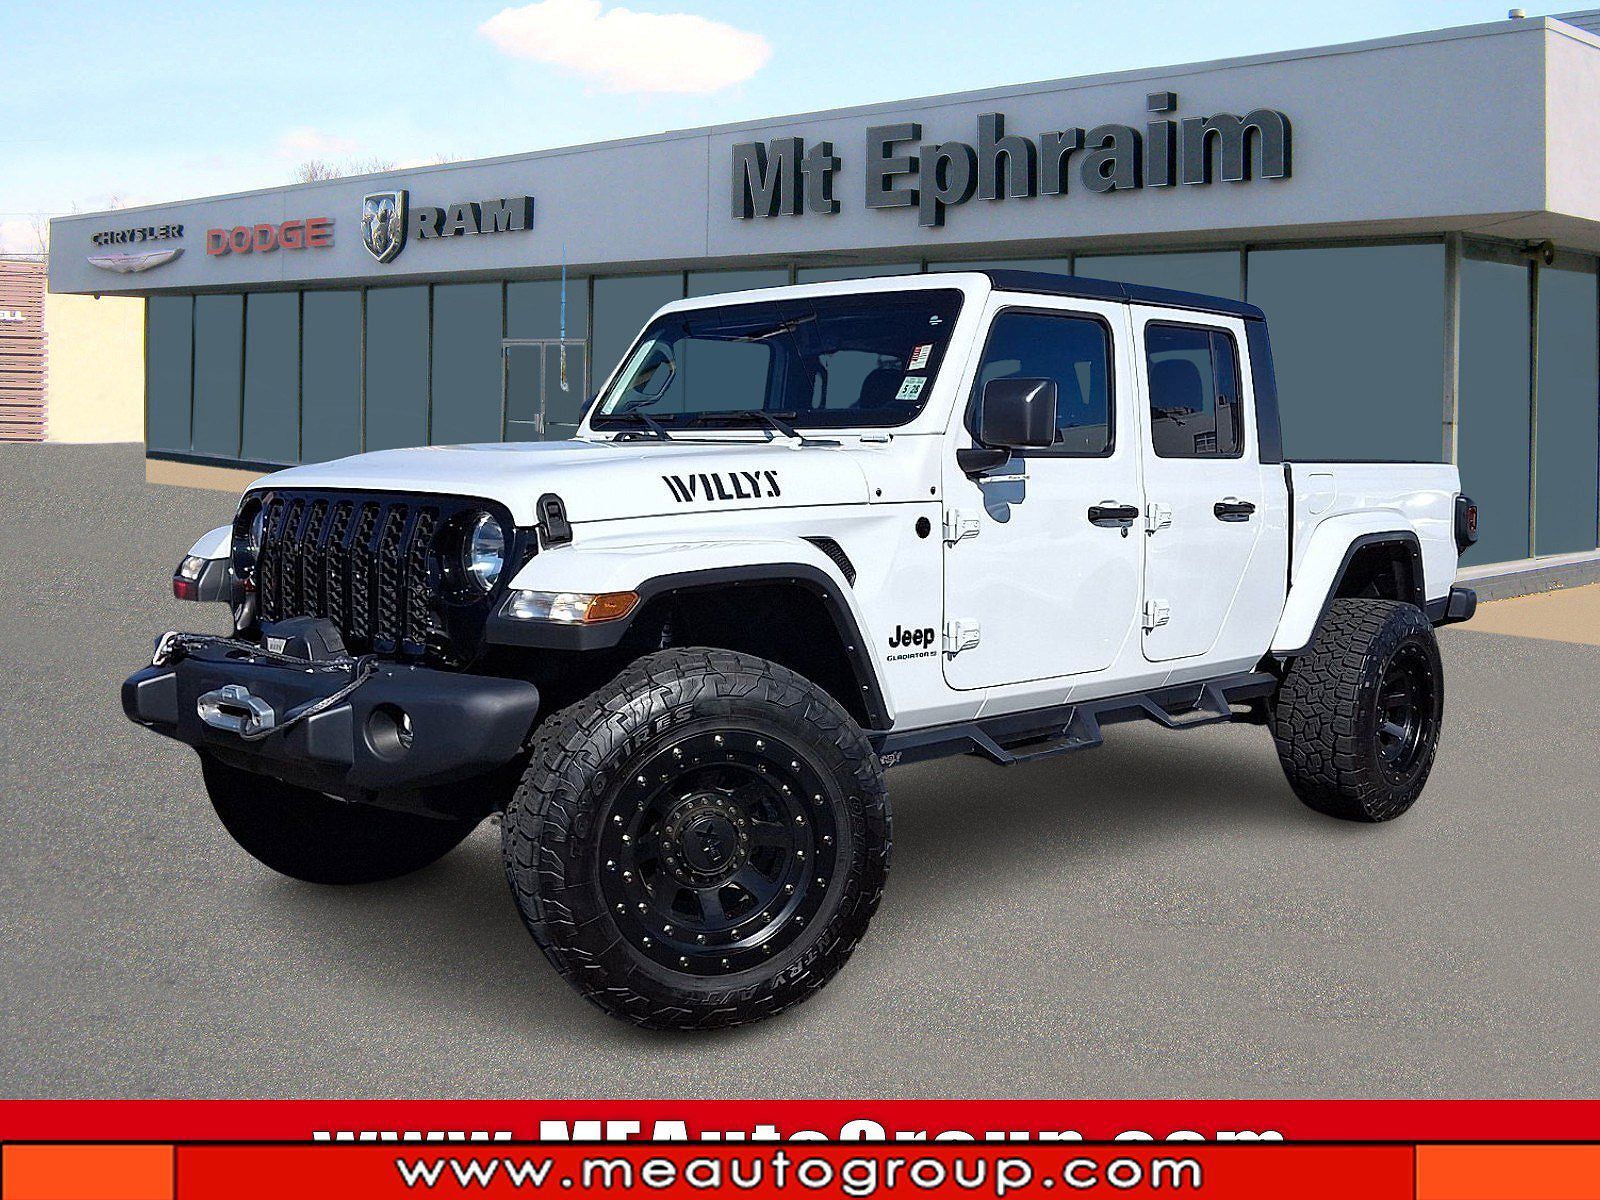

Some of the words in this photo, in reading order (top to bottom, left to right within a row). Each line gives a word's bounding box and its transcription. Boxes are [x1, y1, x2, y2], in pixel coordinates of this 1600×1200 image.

[731, 136, 842, 219] Mt
[866, 90, 1292, 226] Ephraim
[90, 223, 185, 246] CHRYSLER
[416, 195, 535, 239] RAM
[206, 217, 335, 256] DODGE
[661, 470, 781, 503] WILLYS
[888, 625, 935, 649] Jeep
